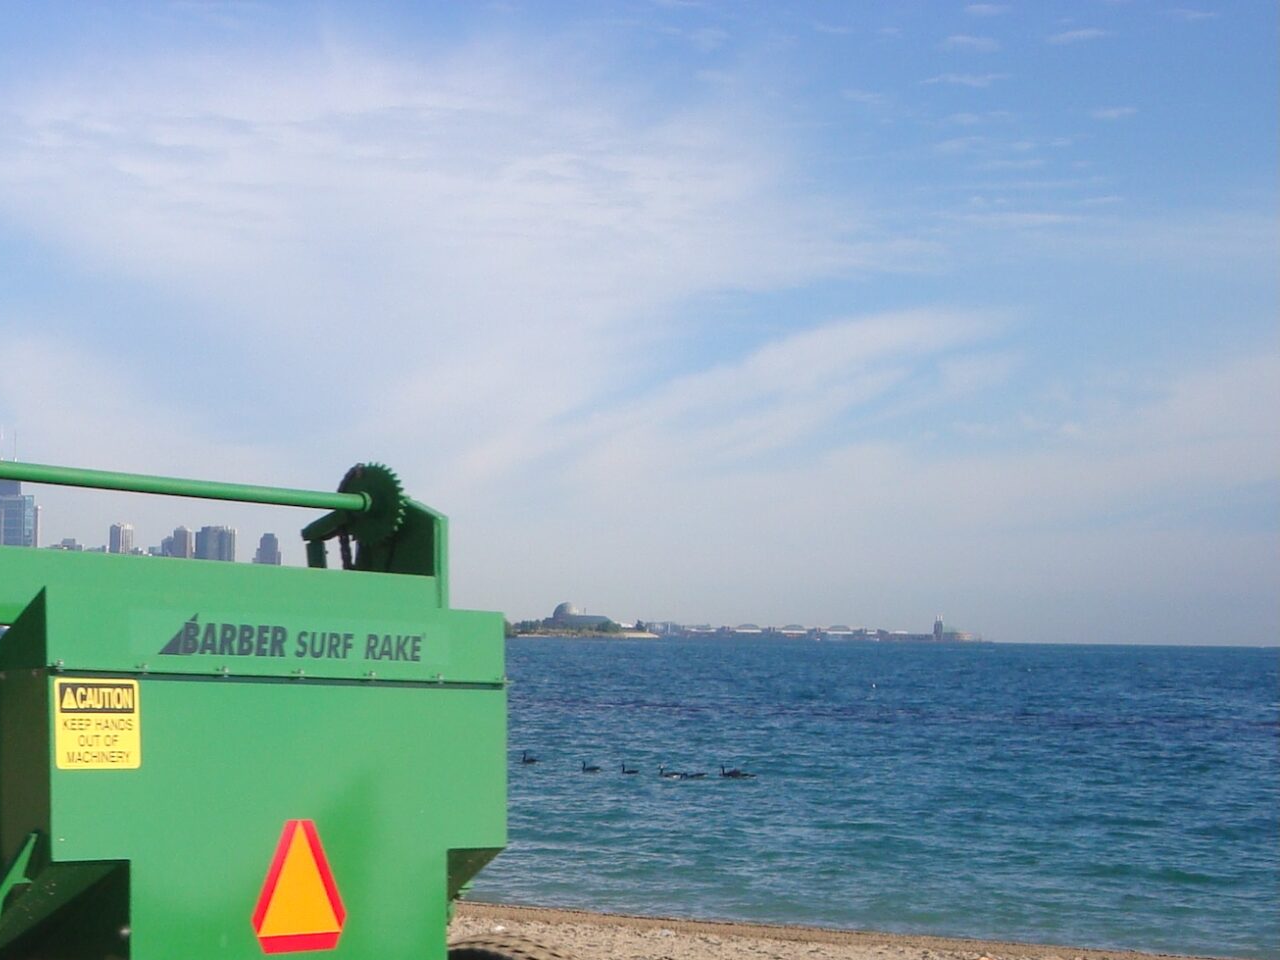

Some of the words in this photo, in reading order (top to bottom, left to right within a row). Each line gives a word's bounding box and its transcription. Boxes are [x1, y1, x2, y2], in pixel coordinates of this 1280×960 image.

[181, 621, 288, 657] BARBER
[295, 631, 355, 659] SURF
[364, 633, 422, 662] RAKE
[76, 687, 133, 709] CAUTION
[62, 718, 92, 731] KEEP
[94, 718, 134, 731] HANDS
[77, 734, 101, 747] OUT
[104, 734, 119, 747] OF
[66, 751, 132, 763] MACHINERY
